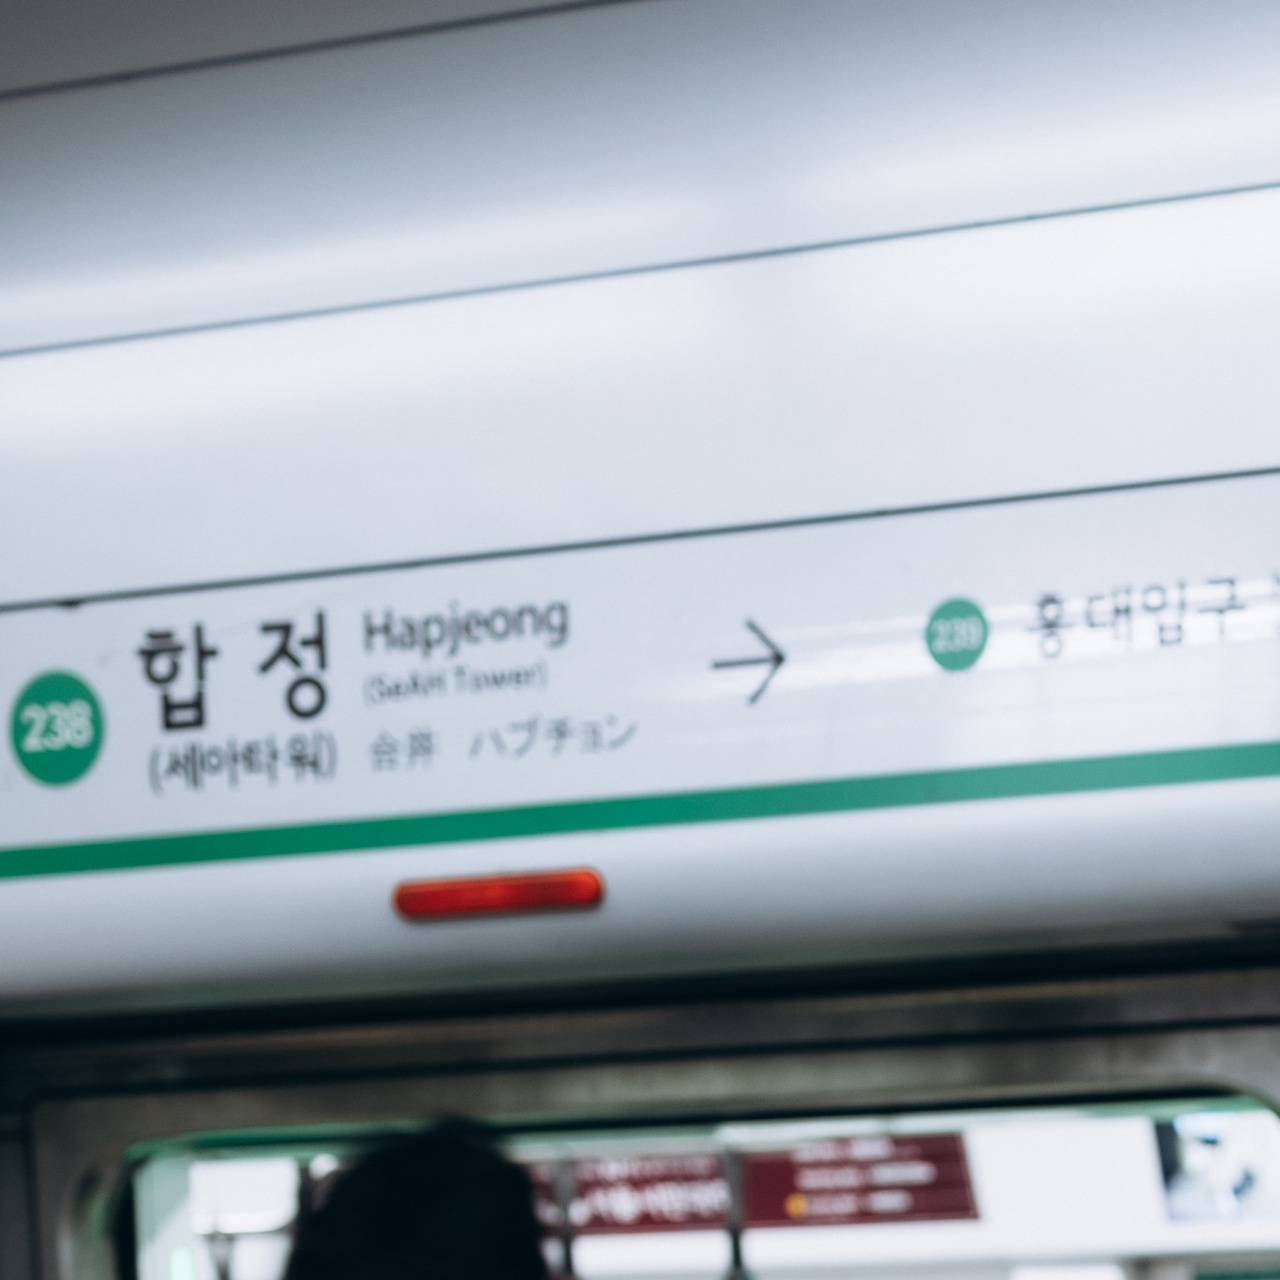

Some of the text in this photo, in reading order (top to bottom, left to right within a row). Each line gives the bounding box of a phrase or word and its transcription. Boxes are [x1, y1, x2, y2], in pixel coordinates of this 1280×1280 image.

[363, 600, 570, 659] Hapjeong
[930, 617, 985, 654] 239
[1028, 579, 1247, 658] 홍대입구
[455, 660, 550, 696] Tower)
[20, 697, 94, 753] 238
[149, 731, 336, 793] (세아타워)
